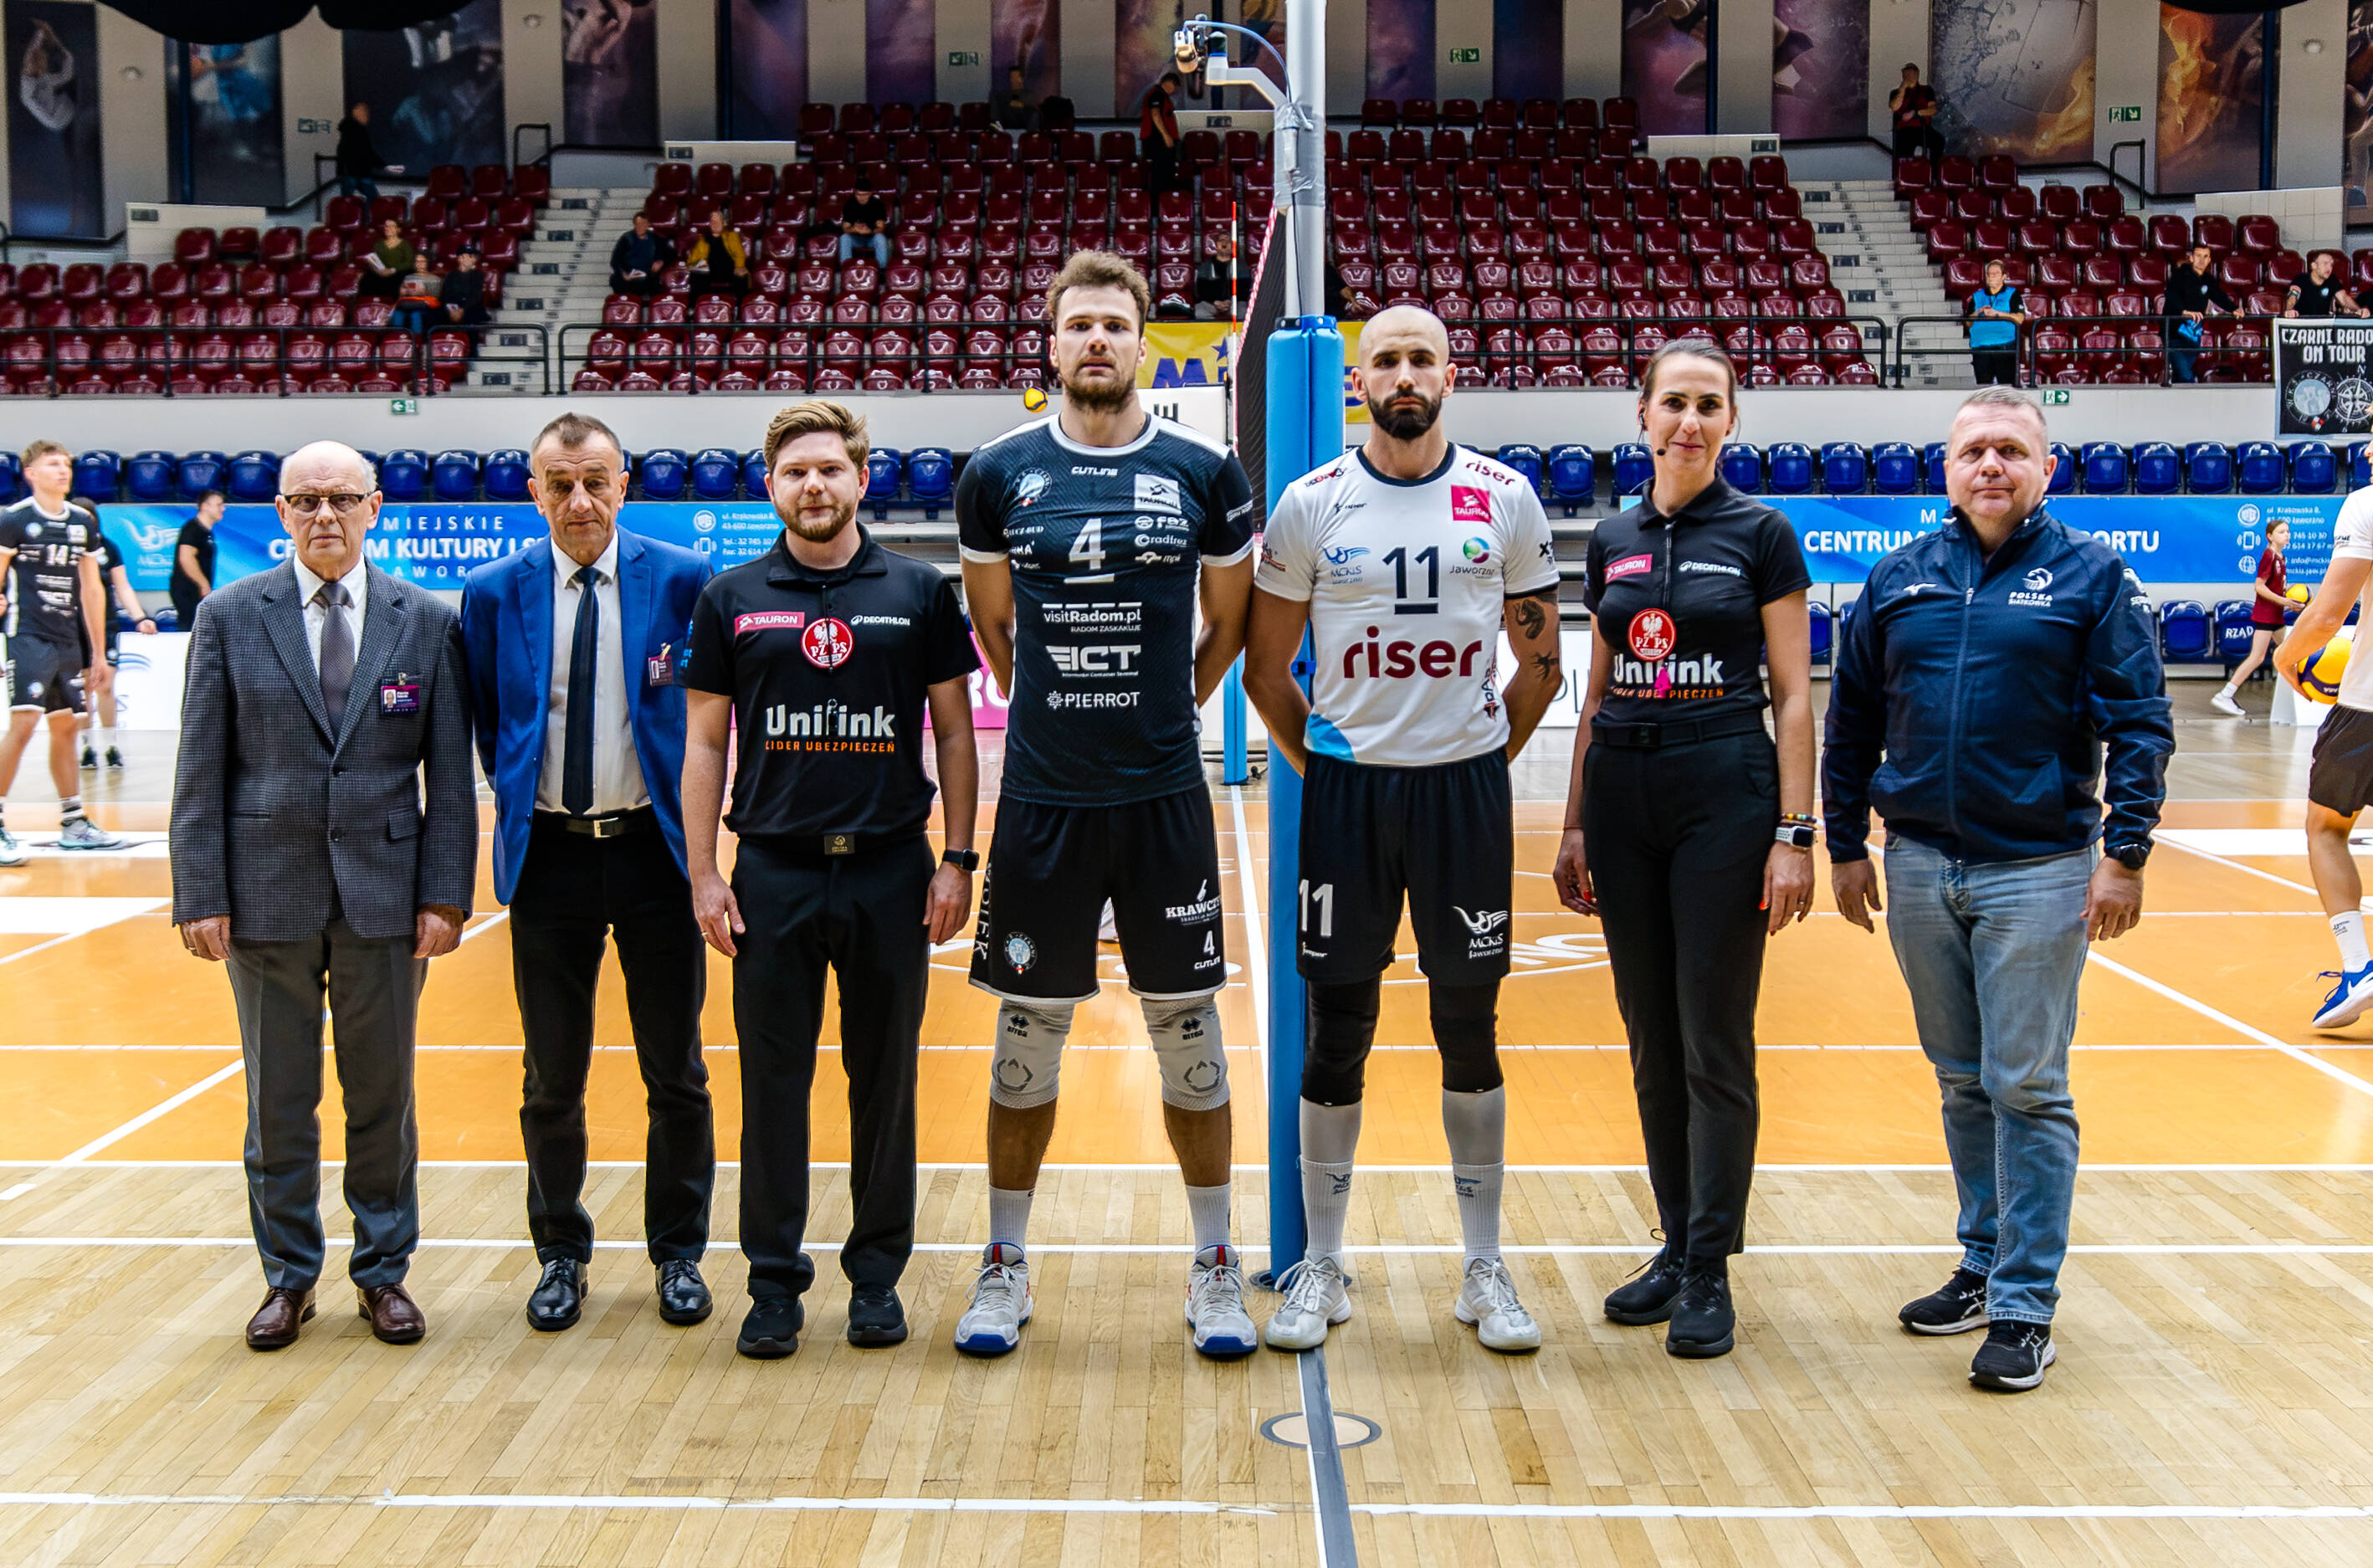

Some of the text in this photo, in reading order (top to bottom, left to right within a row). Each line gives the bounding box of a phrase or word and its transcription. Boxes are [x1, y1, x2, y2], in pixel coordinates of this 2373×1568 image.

[2281, 328, 2334, 345] CZARNI
[2303, 345, 2366, 363] ON TOUR
[1071, 465, 1120, 477] CUTLINE
[1465, 461, 1516, 486] riser
[382, 515, 505, 531] MIEJSKIE
[397, 537, 503, 559] KULTURY
[1069, 518, 1106, 571] 4
[2080, 530, 2160, 553] ORTU
[46, 544, 69, 566] 14
[1382, 545, 1439, 599] 11
[1613, 559, 1646, 574] TAURON
[1692, 562, 1740, 577] DECATHLON
[2009, 592, 2053, 601] POLSKA
[753, 615, 798, 624] TAURON
[864, 615, 911, 626] DECATHLON
[1043, 608, 1142, 623] visitRadom.pl
[1071, 625, 1099, 633] RADOM
[1343, 625, 1483, 679] riser
[1064, 692, 1140, 709] PIERROT
[1637, 688, 1724, 699] UBEPIECZEŃ
[765, 740, 800, 751] LIDER
[1299, 879, 1334, 937] 11
[1203, 930, 1215, 956] 4
